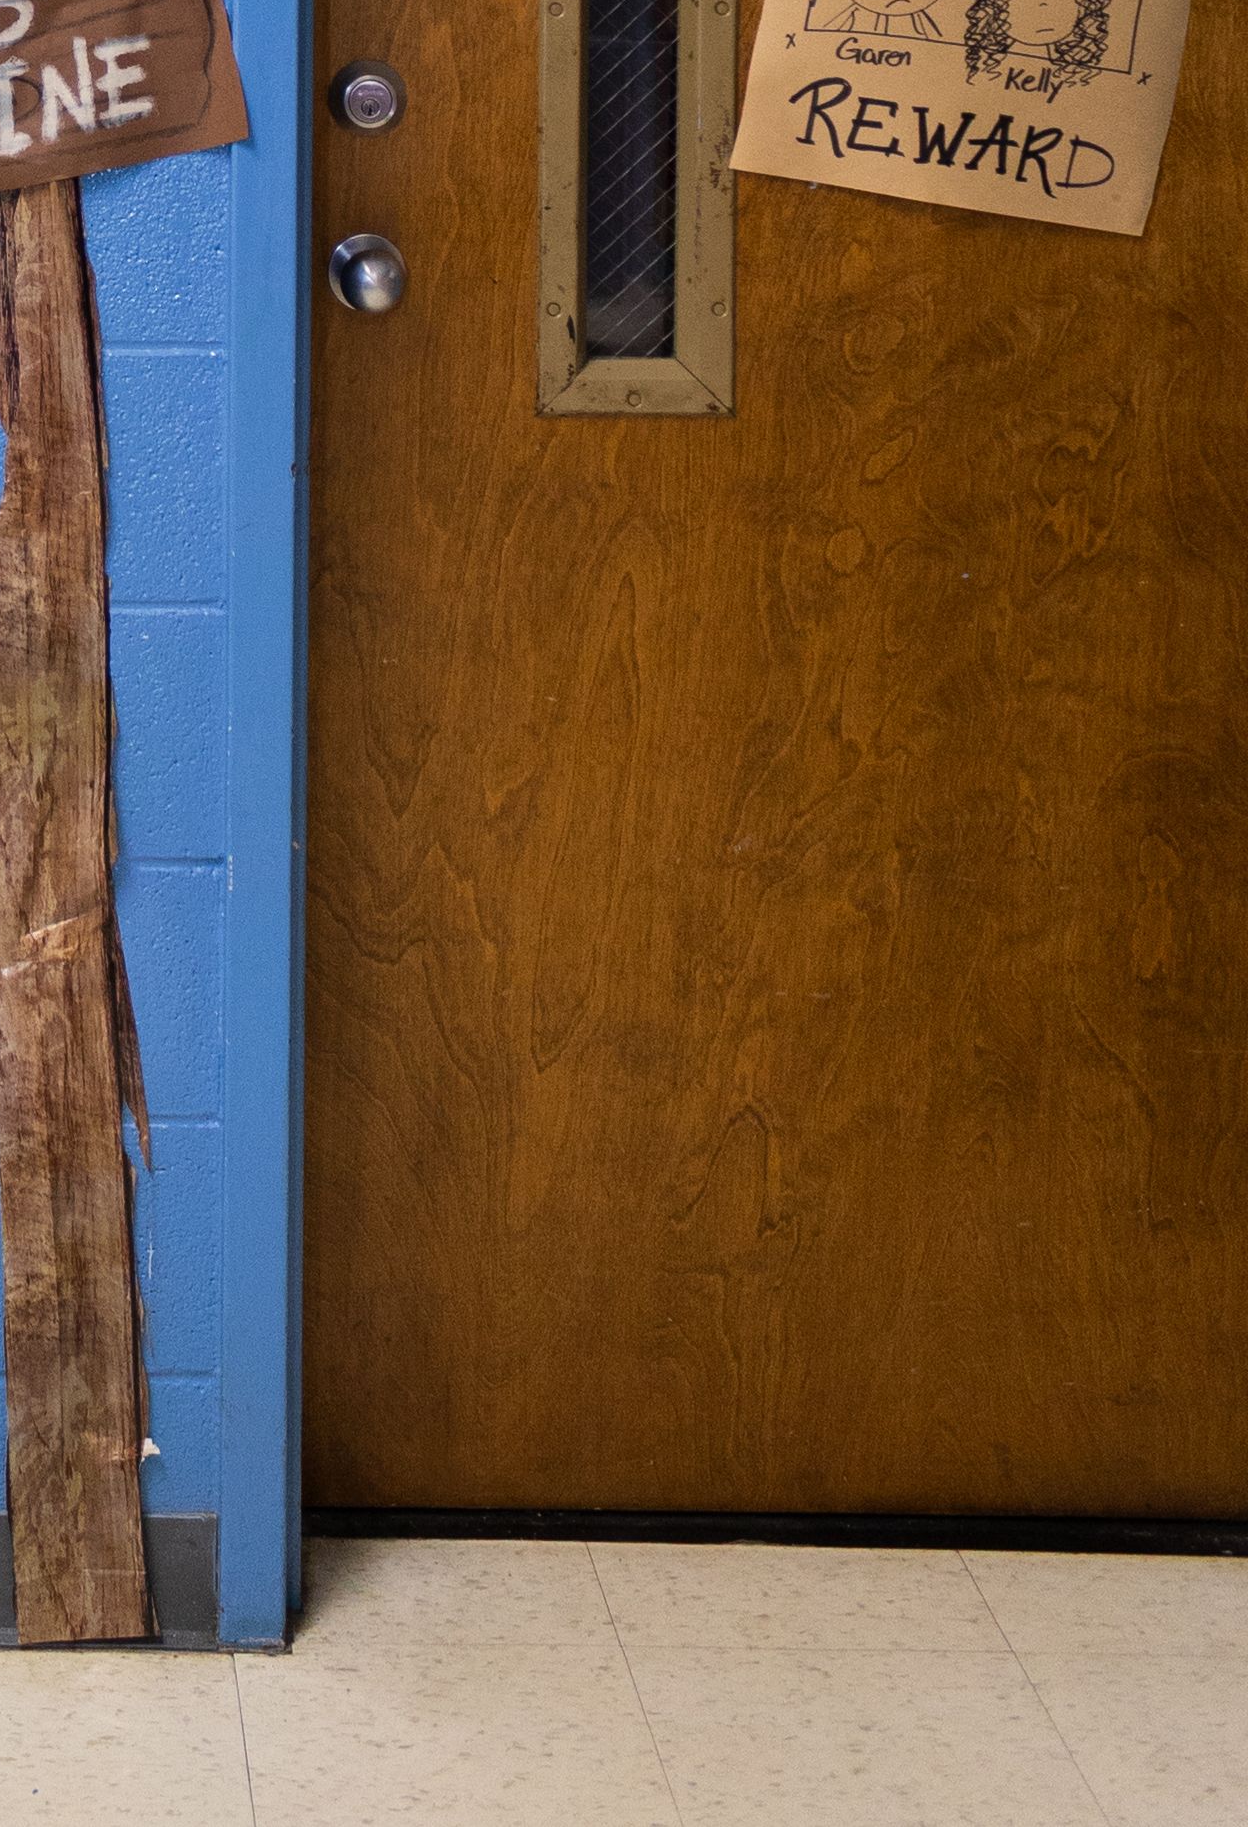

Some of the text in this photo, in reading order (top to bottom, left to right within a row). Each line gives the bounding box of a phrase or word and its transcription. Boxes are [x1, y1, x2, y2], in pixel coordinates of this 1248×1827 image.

[835, 36, 912, 67] Garen
[1004, 67, 1064, 104] Kelly
[789, 76, 1115, 199] REWARD
